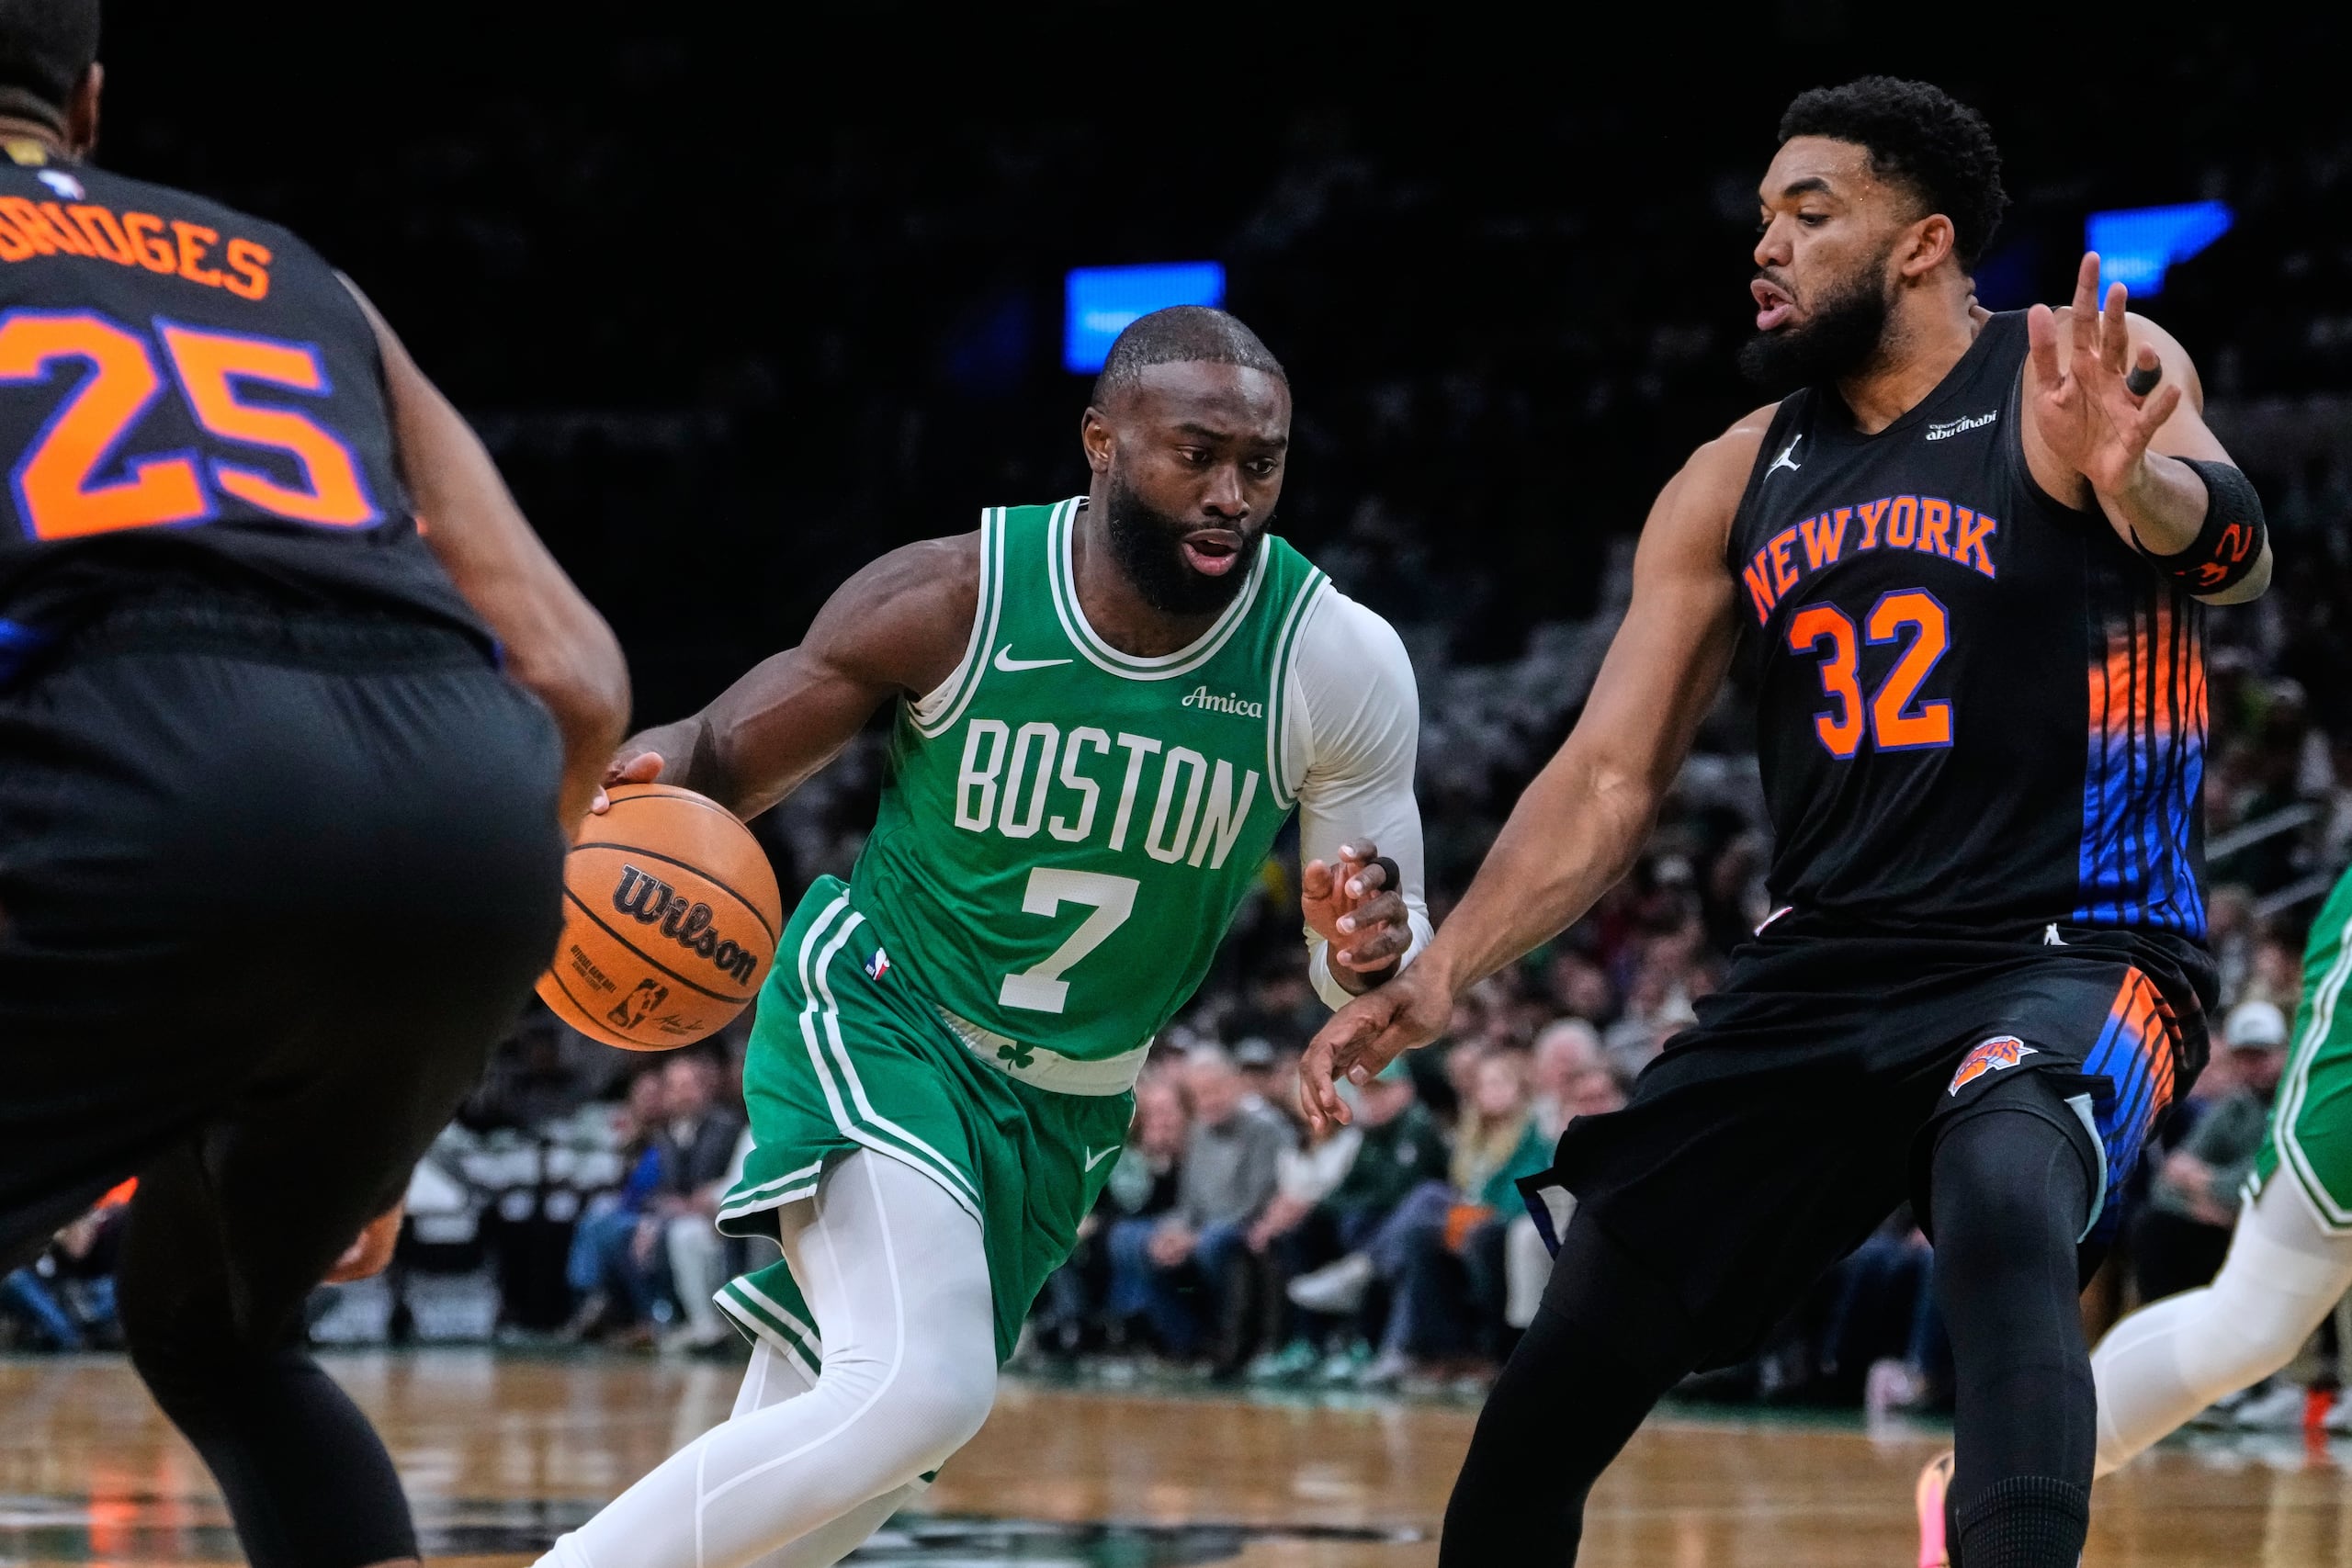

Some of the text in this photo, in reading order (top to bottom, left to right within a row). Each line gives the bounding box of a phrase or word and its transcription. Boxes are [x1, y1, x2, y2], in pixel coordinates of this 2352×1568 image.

[0, 306, 386, 541] 25
[1742, 494, 1996, 628] NEW YORK
[1182, 685, 1263, 719] Amica
[1787, 586, 1954, 761] 32
[954, 718, 1260, 870] BOSTON
[612, 863, 758, 987] Wilson
[998, 866, 1140, 1014] 7
